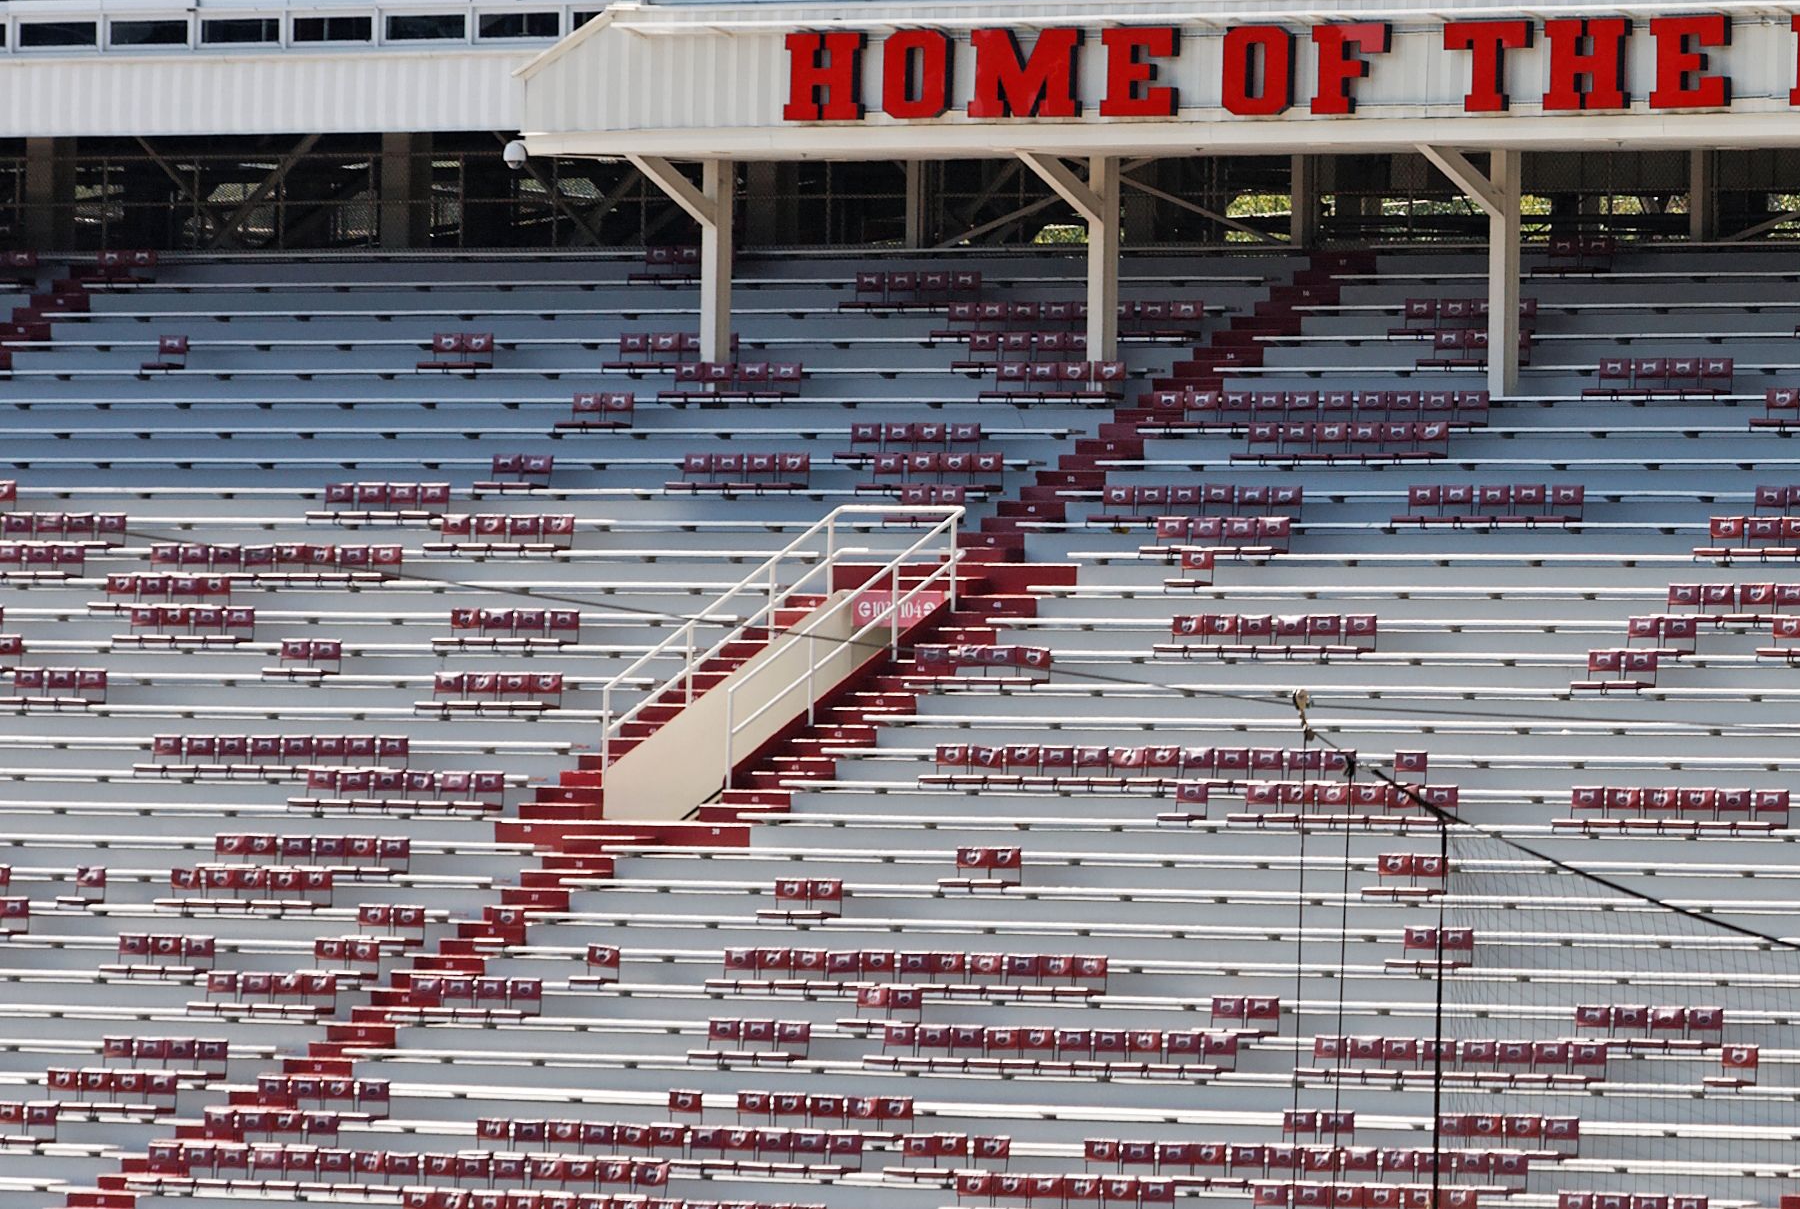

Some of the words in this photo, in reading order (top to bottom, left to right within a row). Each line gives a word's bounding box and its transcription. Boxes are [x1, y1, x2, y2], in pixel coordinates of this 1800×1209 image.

[783, 27, 1181, 121] HOME
[1221, 22, 1392, 116] OF
[1443, 15, 1732, 113] THE
[900, 599, 922, 618] 104
